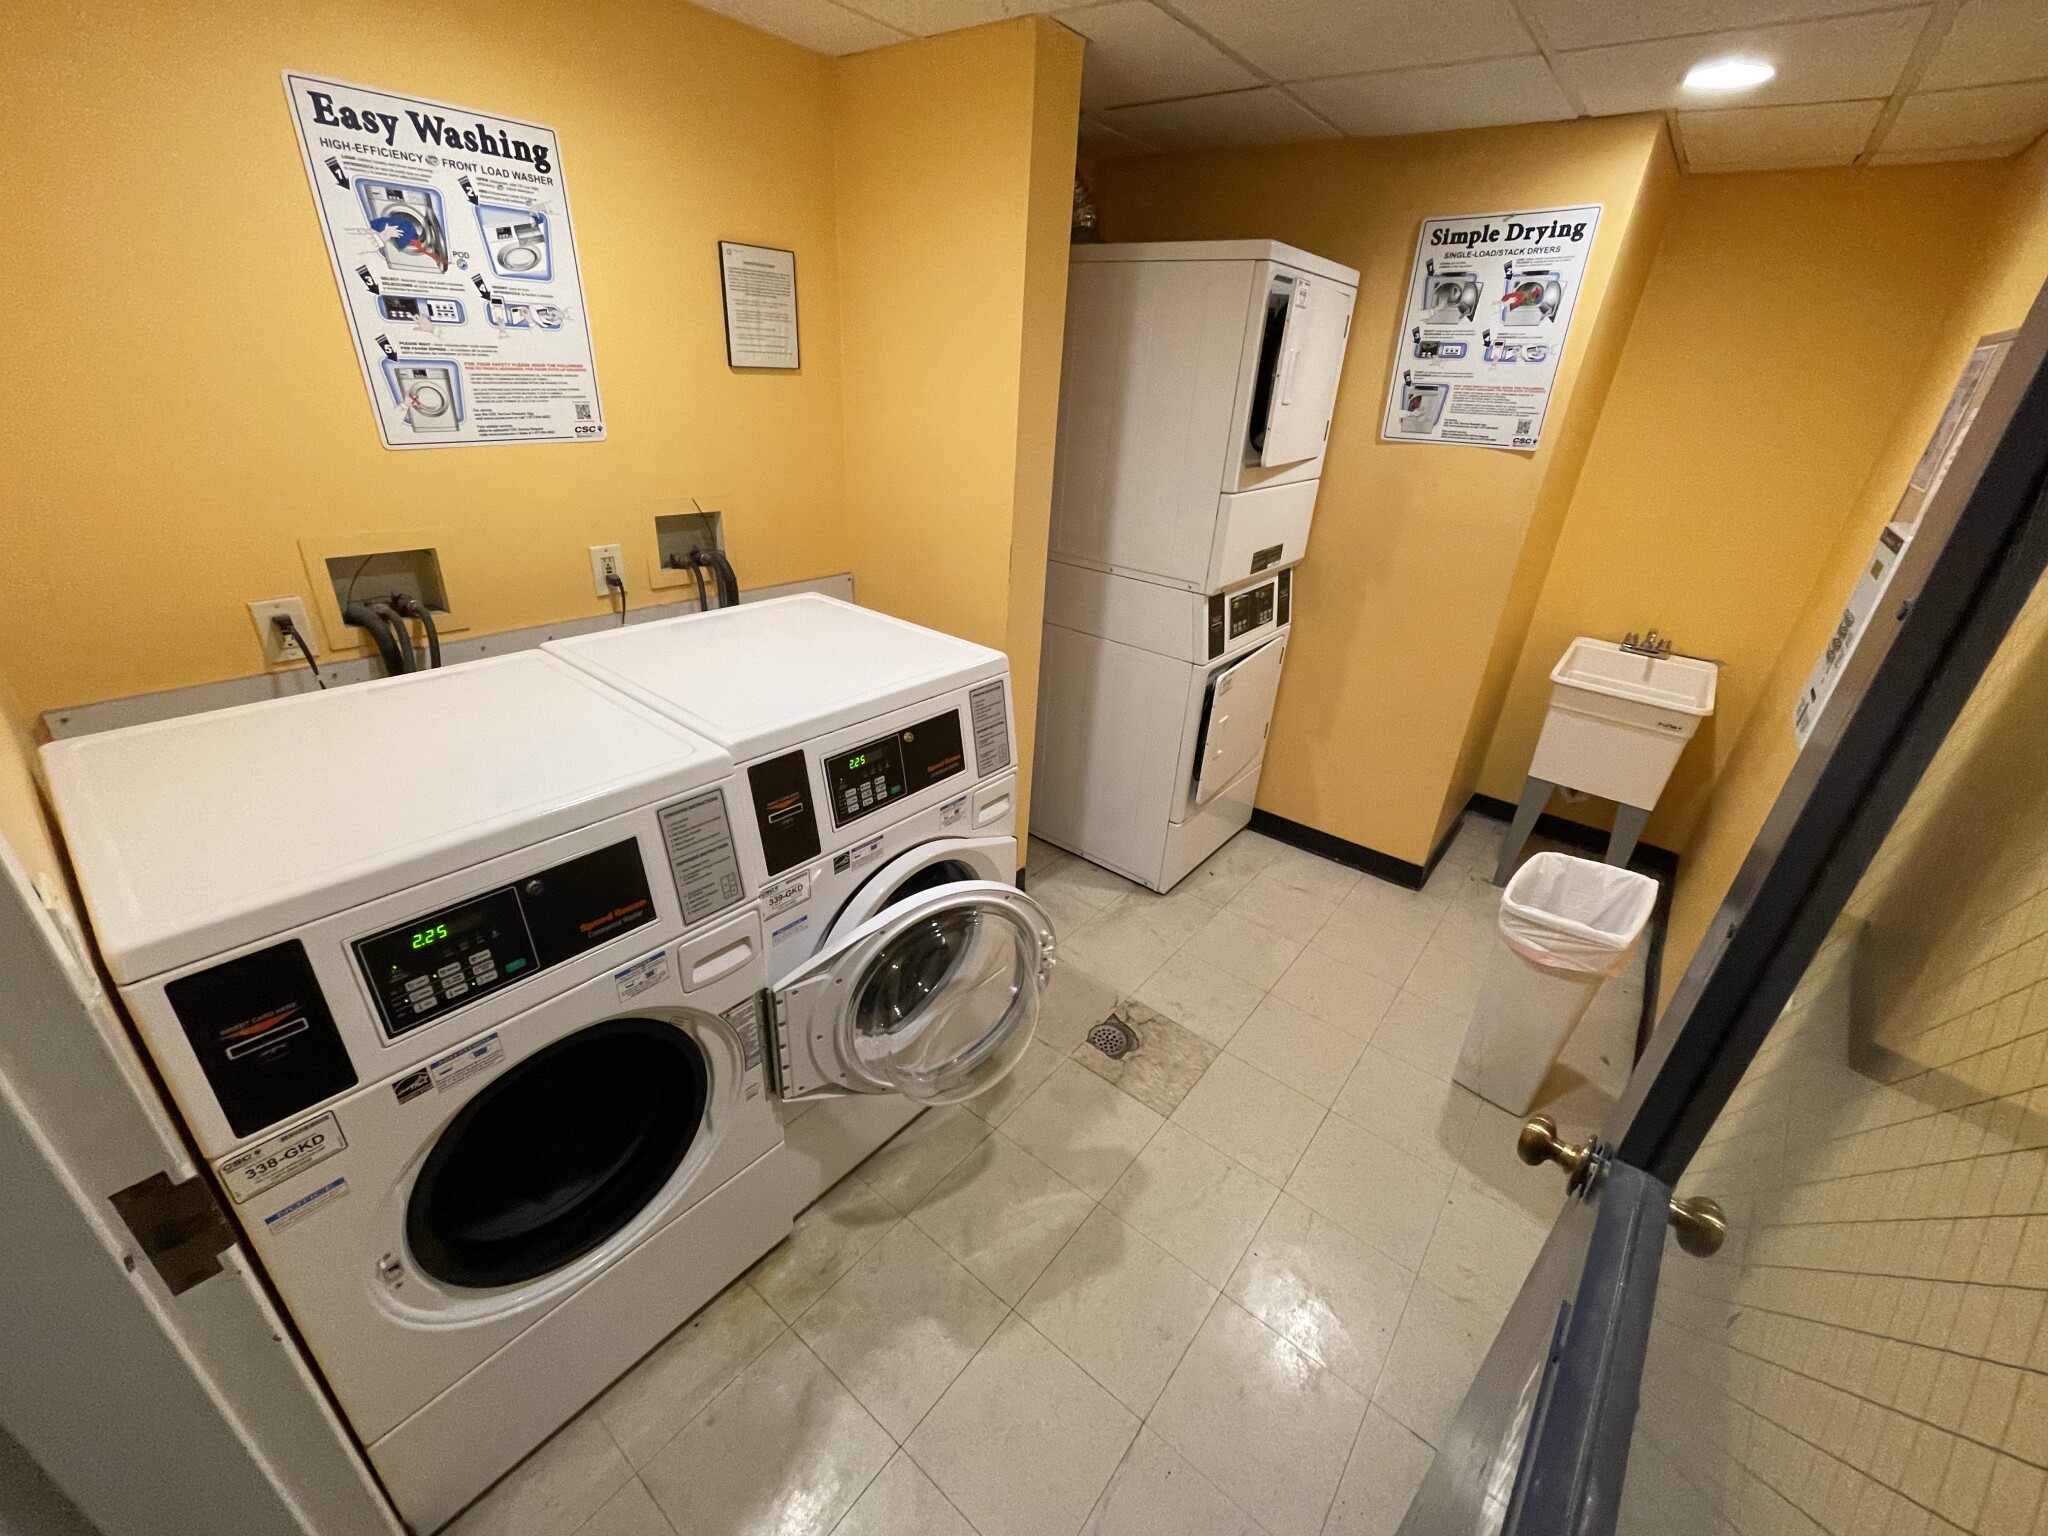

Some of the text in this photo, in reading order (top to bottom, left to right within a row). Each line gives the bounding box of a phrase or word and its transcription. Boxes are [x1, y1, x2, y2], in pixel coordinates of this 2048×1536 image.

[307, 90, 399, 146] Easy
[405, 110, 552, 174] Washing
[319, 137, 423, 164] HIGH-EFFICIENCY
[442, 158, 478, 173] FRONT
[480, 164, 510, 178] LOAD
[511, 170, 554, 186] WASHER
[335, 169, 342, 180] 1
[465, 186, 474, 196] 2
[1431, 220, 1587, 249] Simple Drying
[452, 251, 469, 259] POD
[1444, 246, 1561, 259] SINGLE-LOAD/STACK DRYERS
[364, 276, 374, 286] 3
[384, 344, 392, 354] 5
[574, 425, 596, 433] CSC
[412, 924, 447, 949] 2.25
[245, 1134, 325, 1180] 338-GKD
